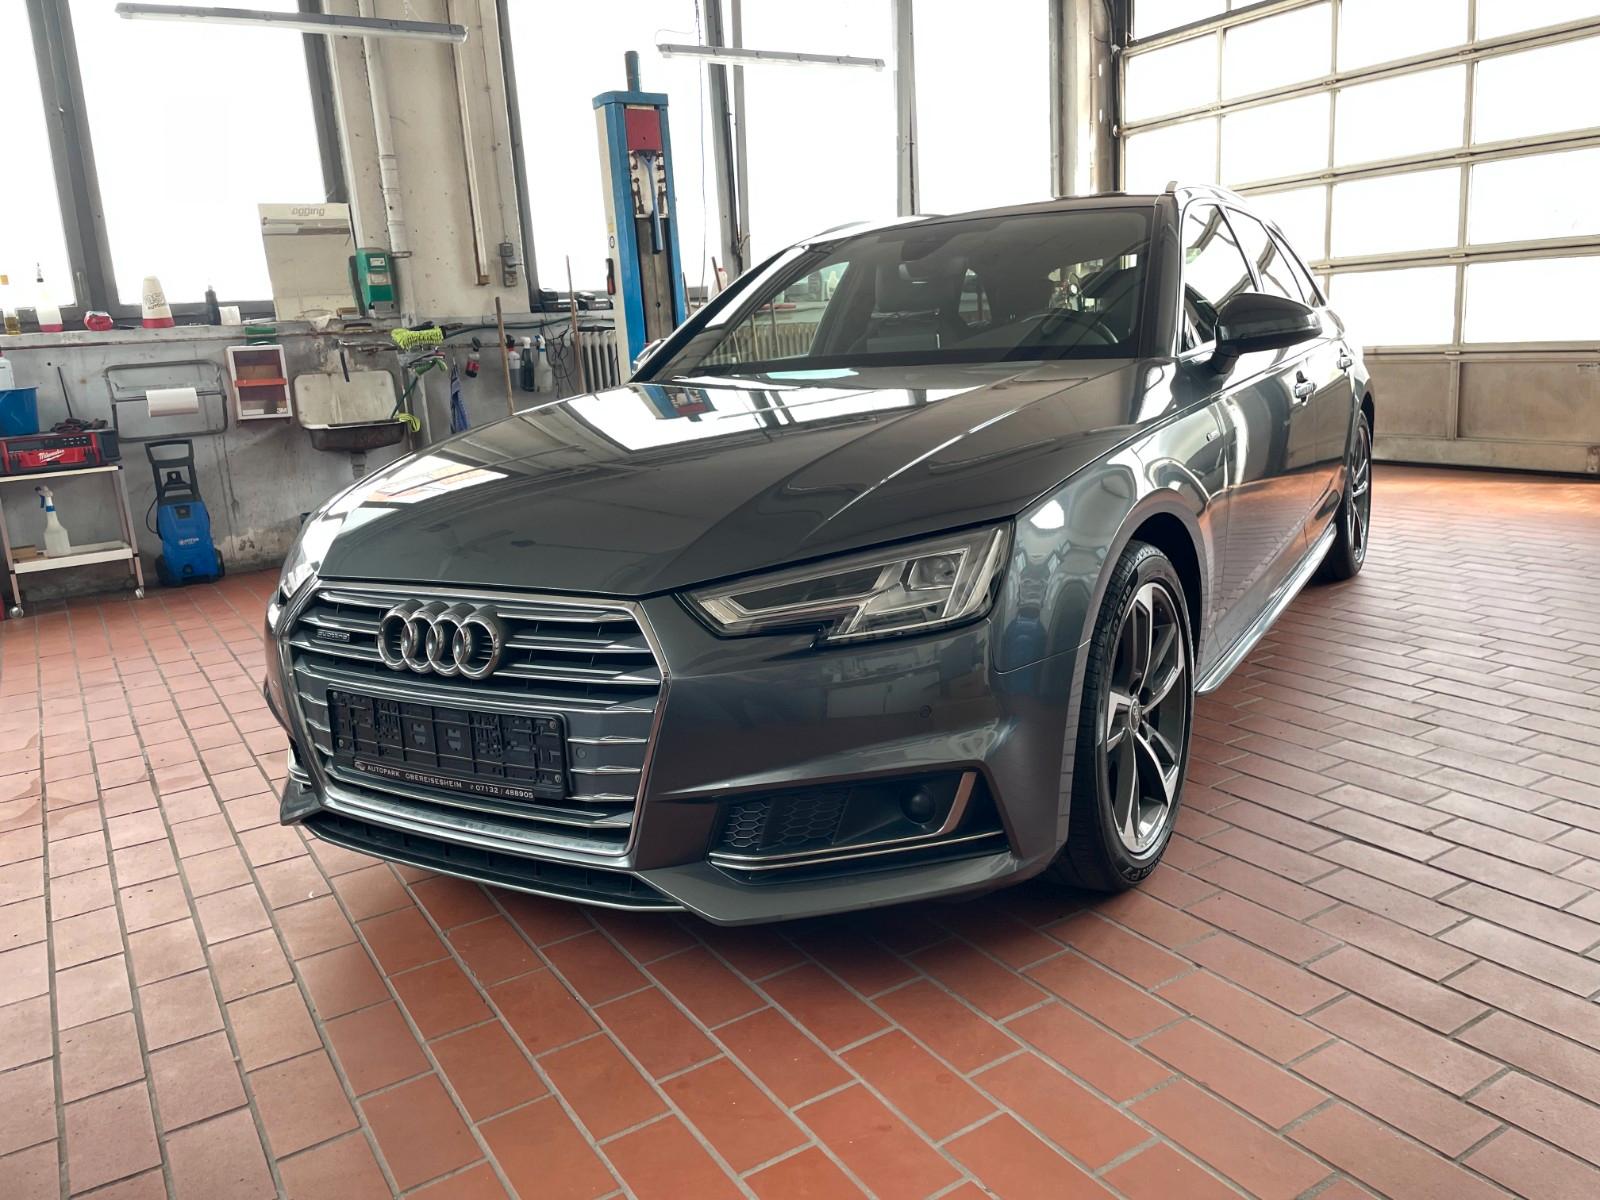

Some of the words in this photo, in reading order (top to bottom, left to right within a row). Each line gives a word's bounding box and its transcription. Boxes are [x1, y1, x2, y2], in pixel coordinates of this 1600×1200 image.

[367, 765, 400, 777] AUTOPARK
[405, 773, 462, 788] OBEREISESHEIM
[475, 784, 499, 794] 07132
